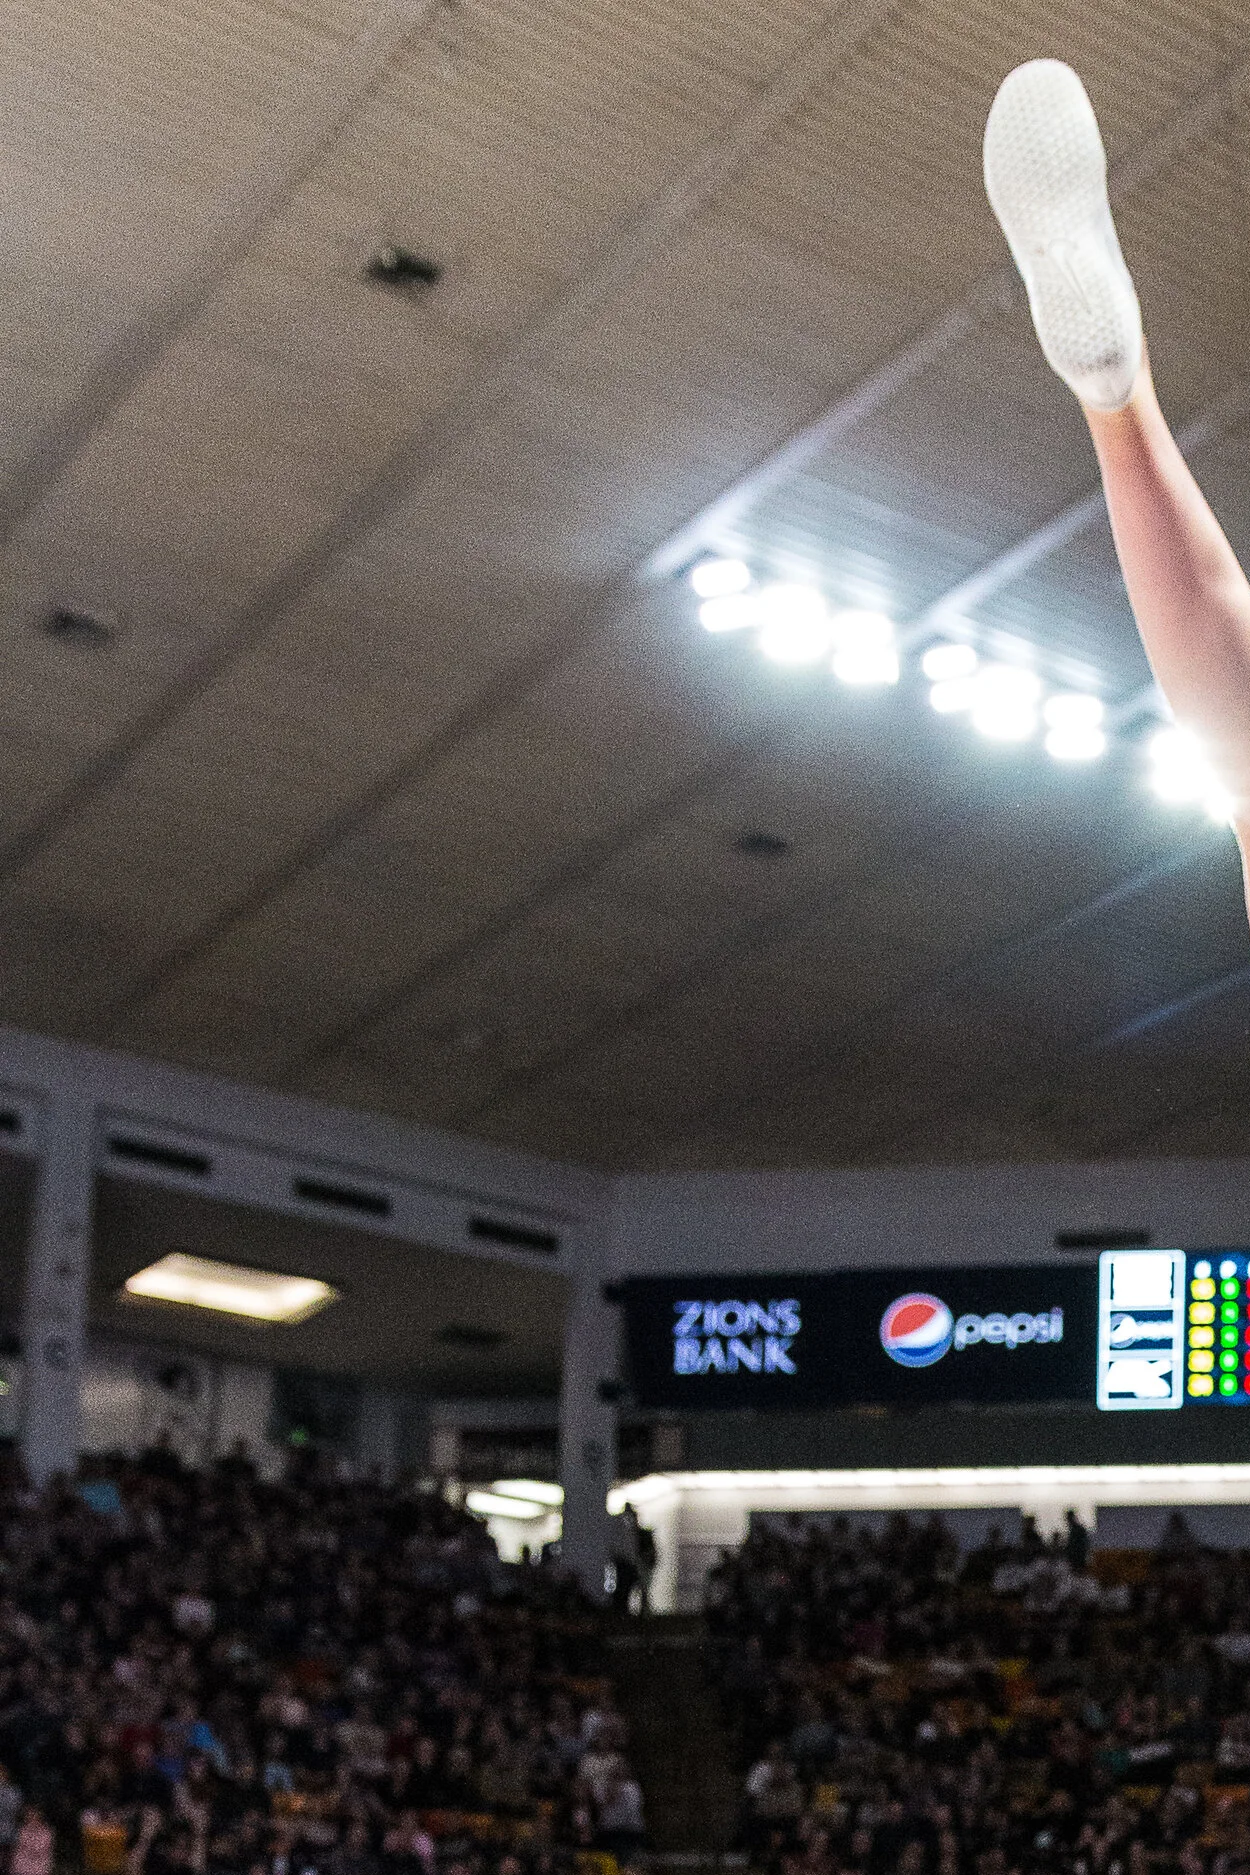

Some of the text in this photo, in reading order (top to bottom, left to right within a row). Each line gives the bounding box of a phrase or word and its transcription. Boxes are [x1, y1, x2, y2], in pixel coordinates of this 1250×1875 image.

[673, 1299, 801, 1337] ZIONS
[954, 1306, 1064, 1352] pepsi
[674, 1337, 797, 1375] BANK
